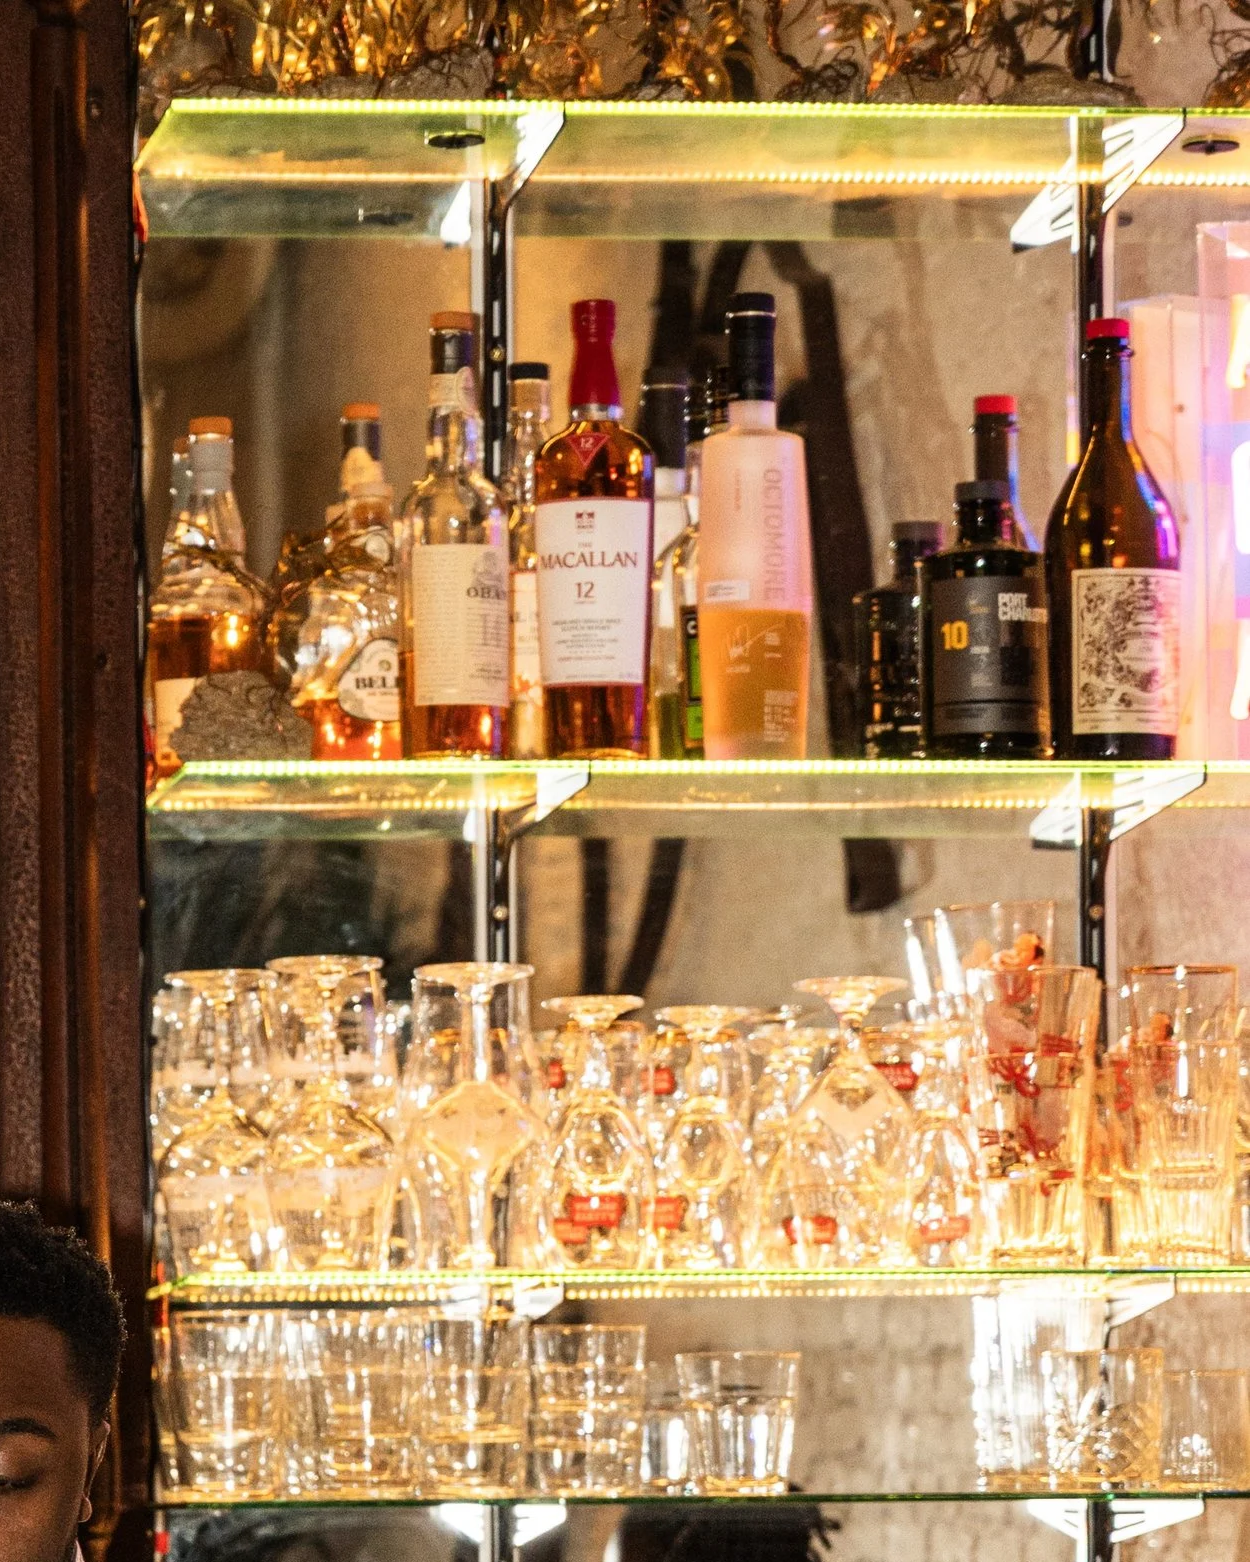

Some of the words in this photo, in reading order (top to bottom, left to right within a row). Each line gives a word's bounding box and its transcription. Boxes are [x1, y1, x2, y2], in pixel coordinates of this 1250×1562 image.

[581, 437, 593, 449] 12
[764, 468, 785, 601] OCTOMORE
[539, 551, 638, 569] MACALLAN
[575, 581, 595, 599] 12
[941, 620, 969, 650] 10
